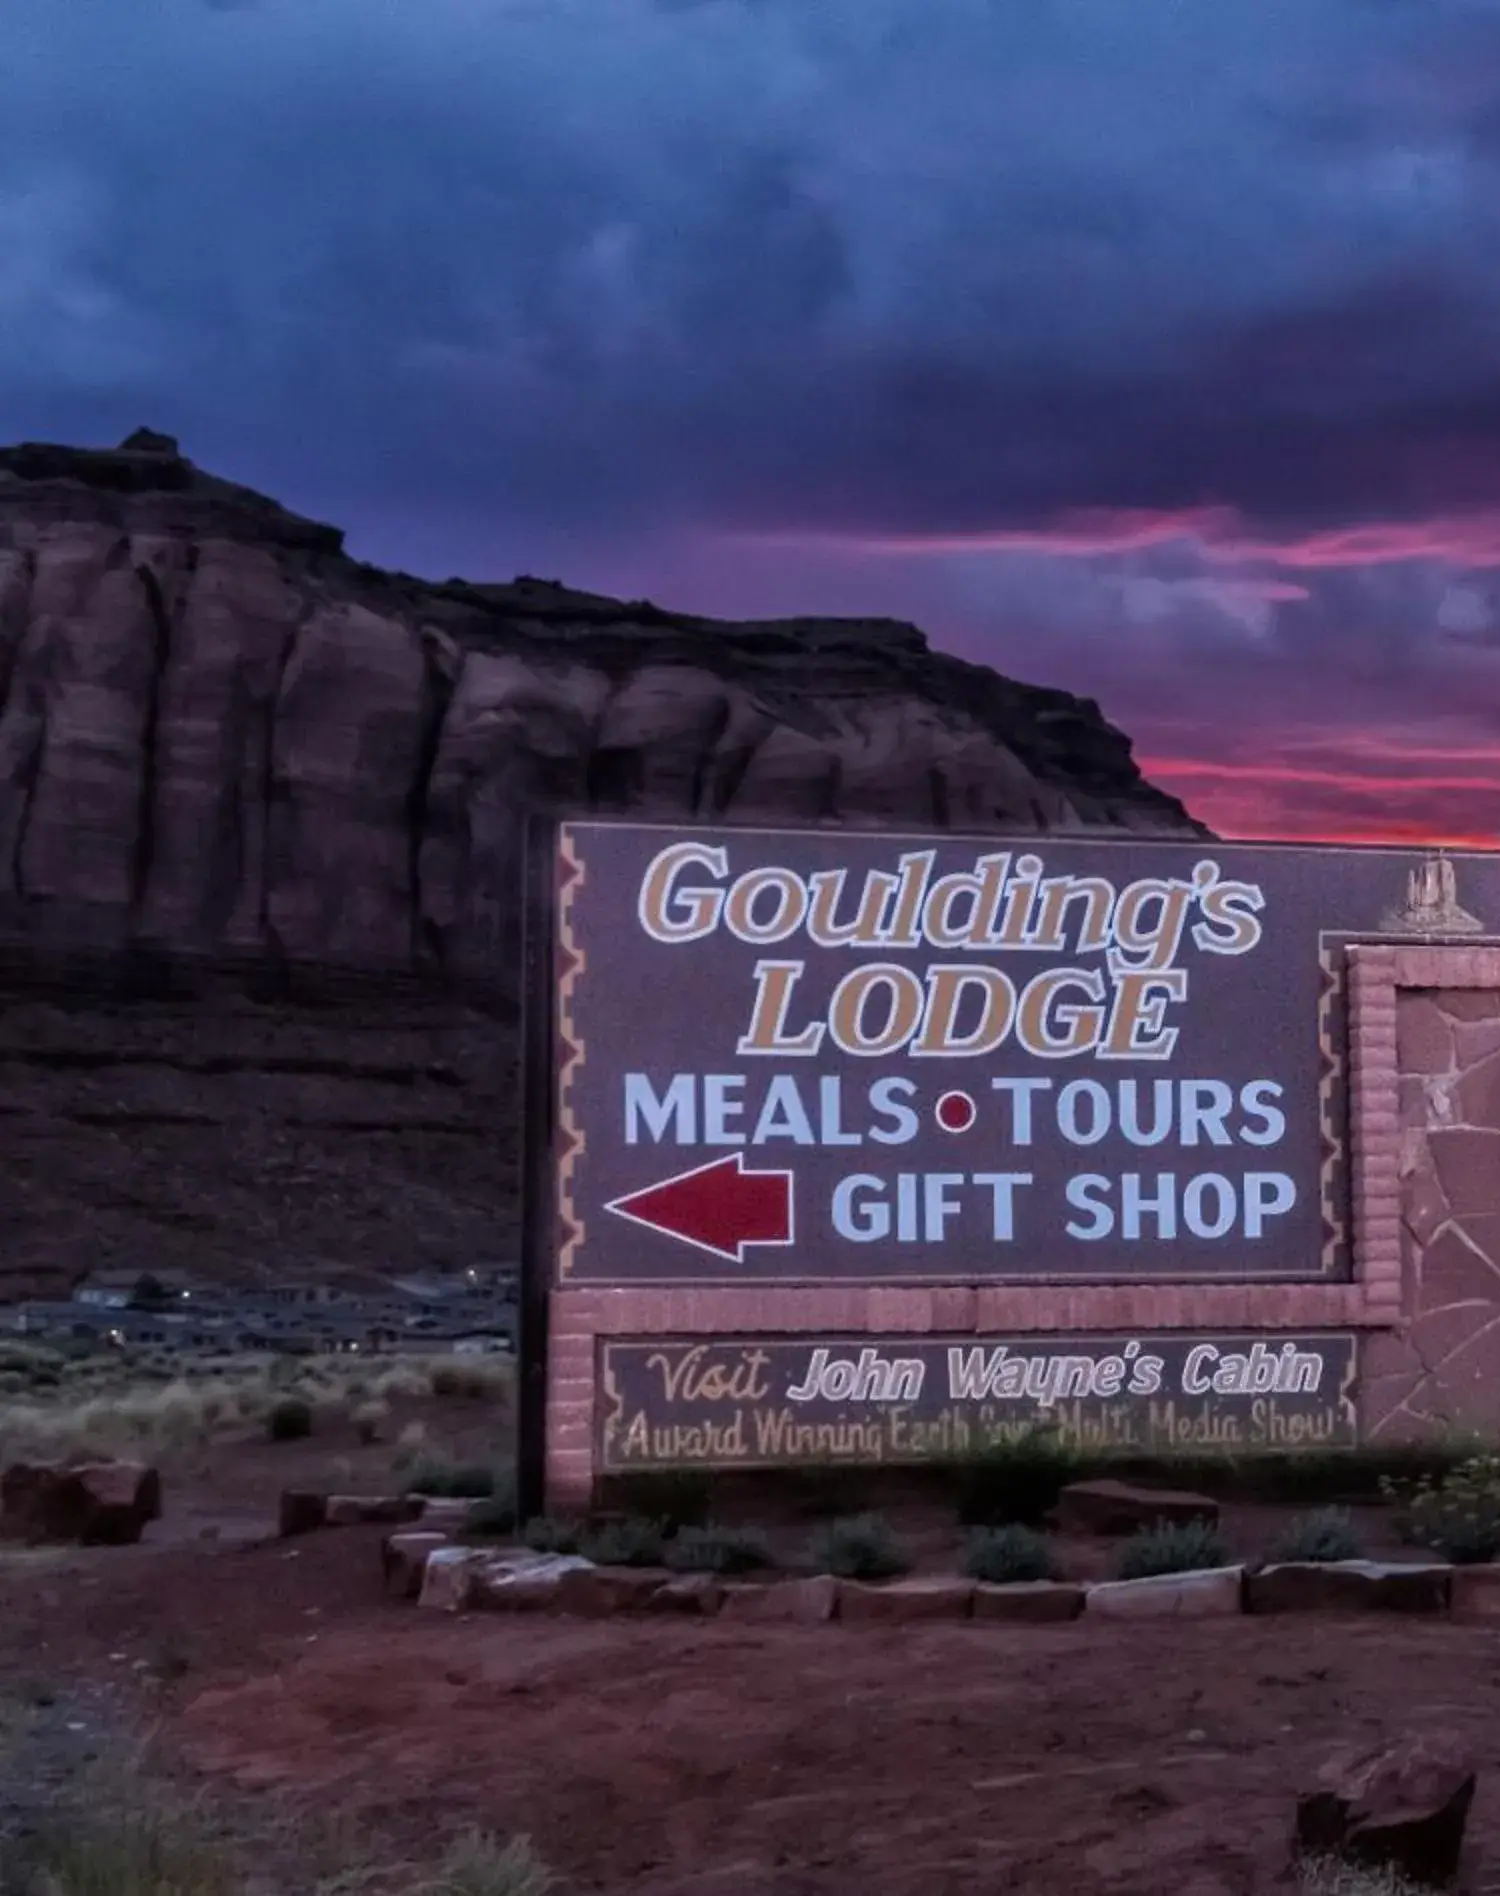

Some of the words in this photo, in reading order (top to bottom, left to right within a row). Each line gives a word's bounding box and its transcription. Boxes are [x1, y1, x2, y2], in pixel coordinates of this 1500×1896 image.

[638, 842, 1265, 975] Goulding's
[737, 960, 1187, 1059] LODGE
[624, 1074, 919, 1145] MEALS
[991, 1078, 1286, 1146] TOURS
[831, 1172, 1033, 1242] GIFT
[1065, 1173, 1297, 1241] SHOP
[646, 1344, 771, 1400] Visit
[786, 1348, 925, 1401] John
[947, 1340, 1165, 1406] Wayne's
[1182, 1342, 1323, 1395] Cabin
[623, 1409, 748, 1457] Award
[753, 1407, 882, 1460] Winning
[1149, 1400, 1242, 1447] Media
[1251, 1398, 1334, 1443] Show
